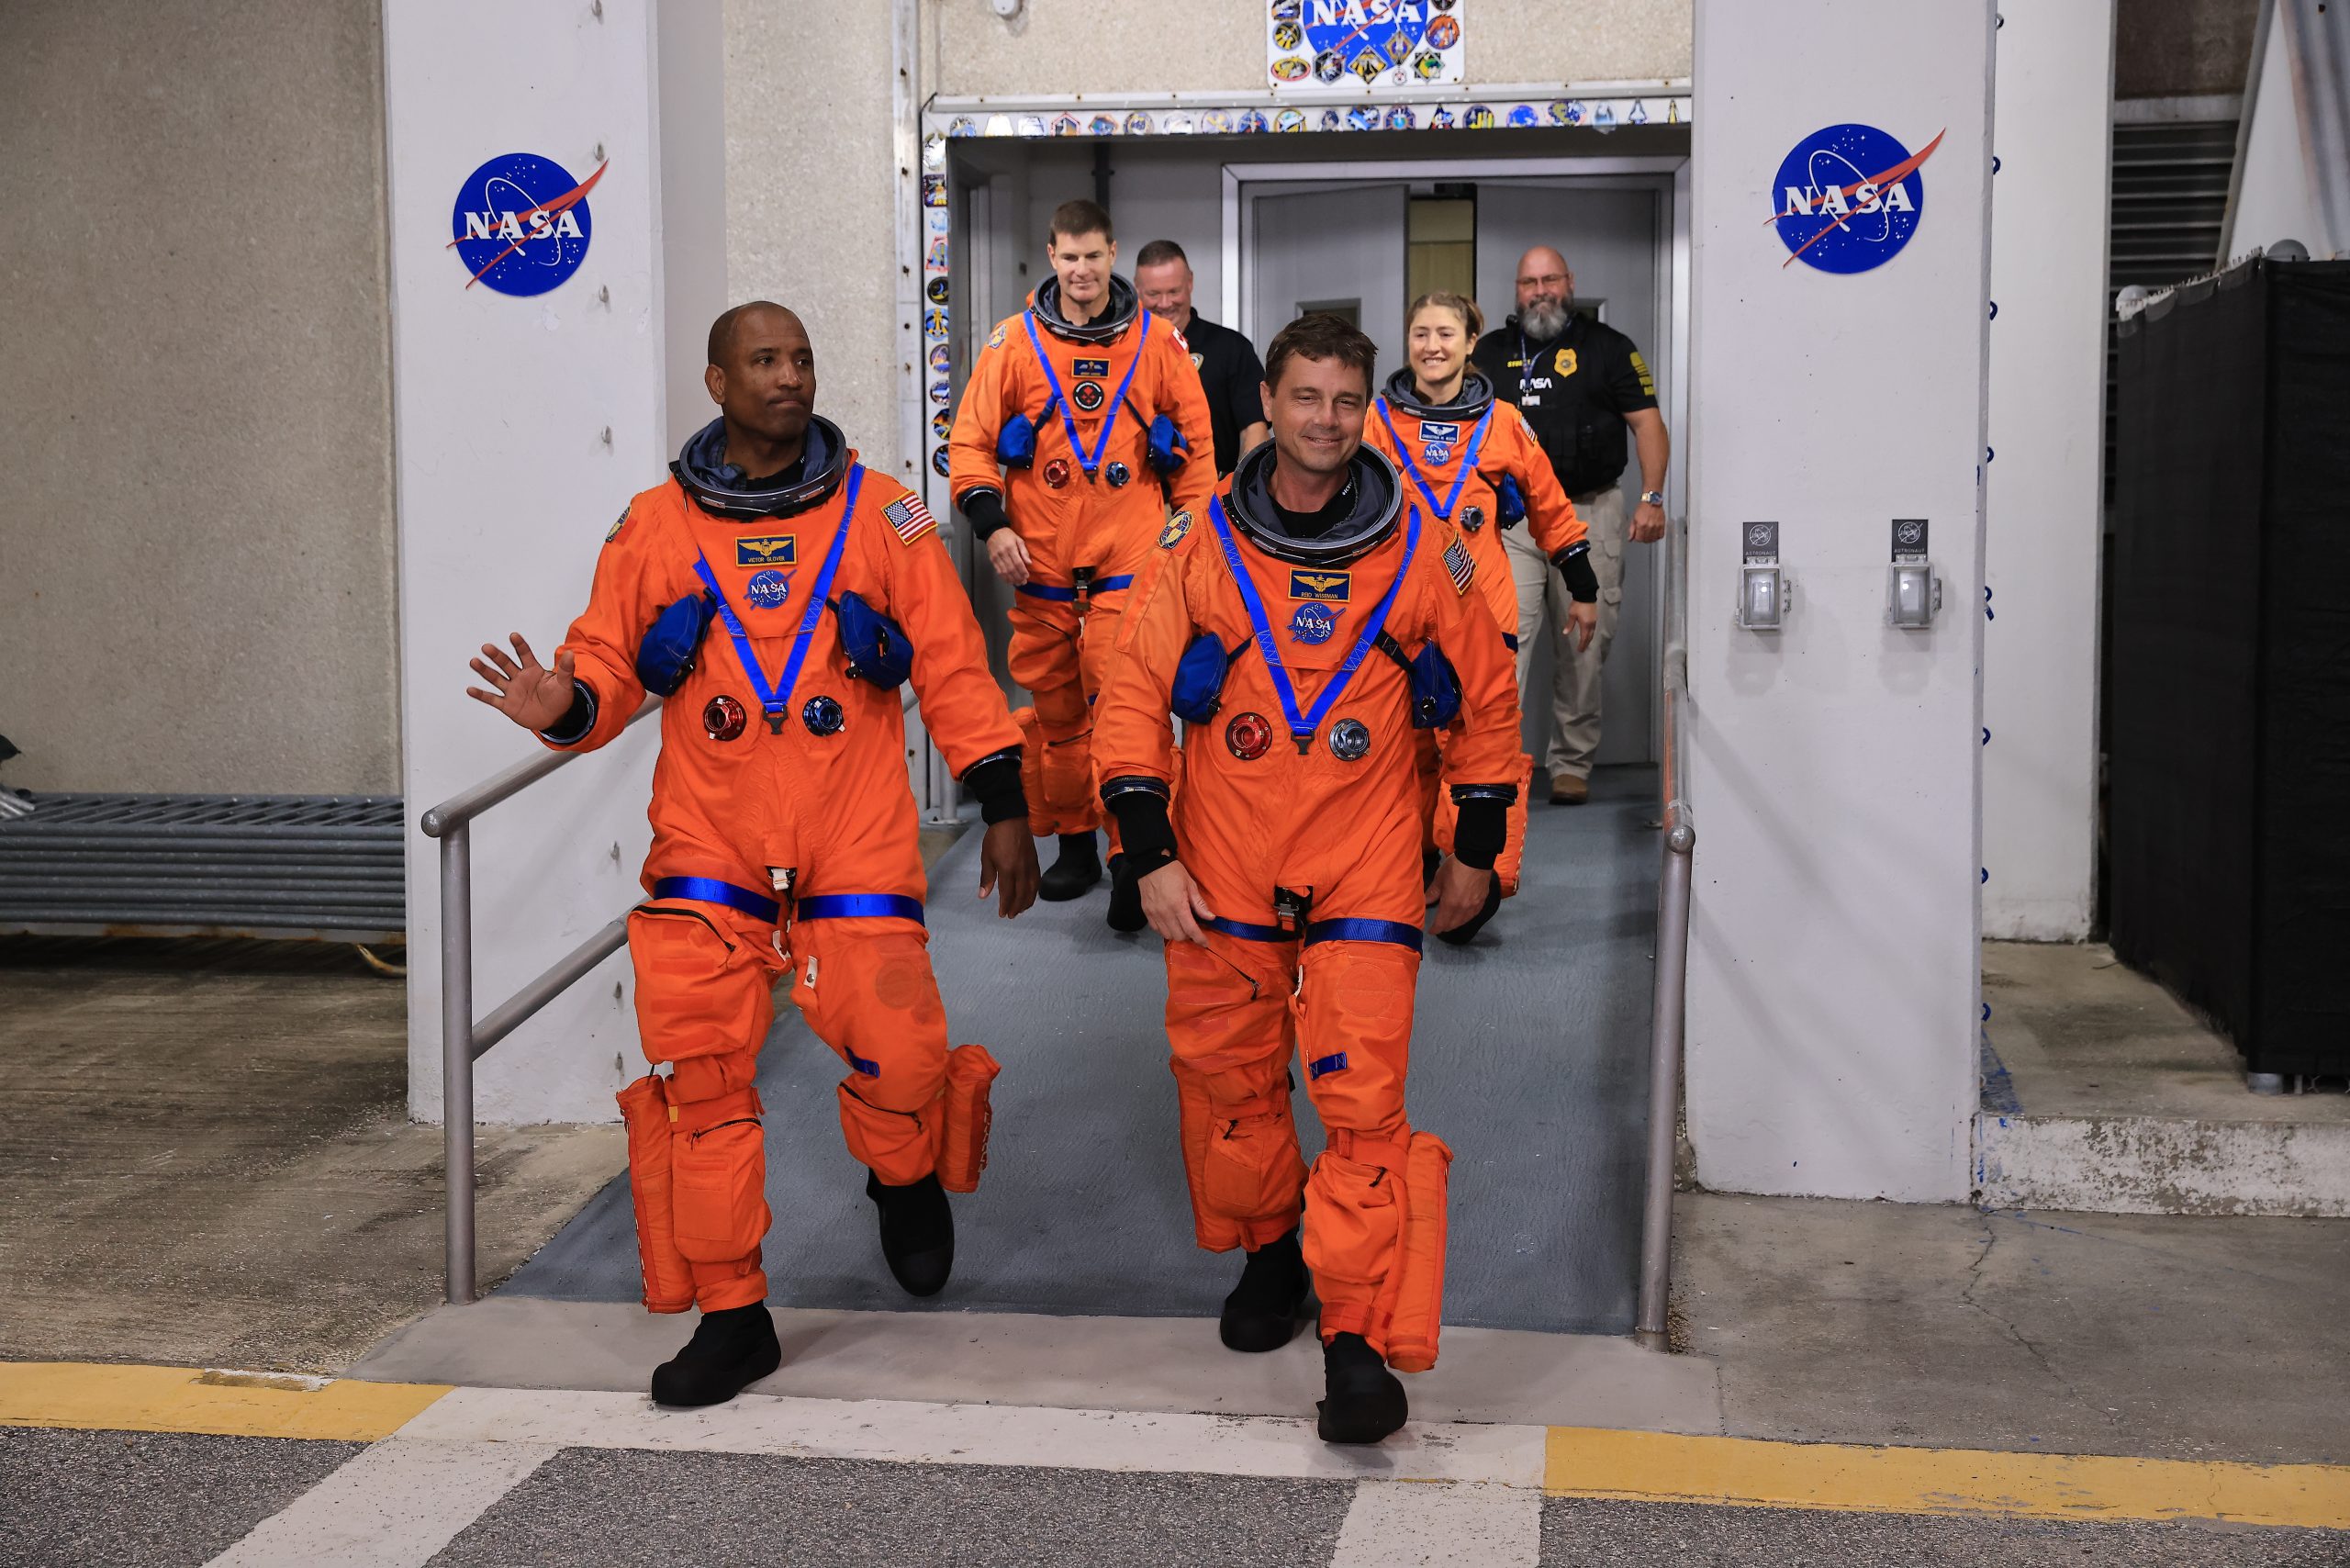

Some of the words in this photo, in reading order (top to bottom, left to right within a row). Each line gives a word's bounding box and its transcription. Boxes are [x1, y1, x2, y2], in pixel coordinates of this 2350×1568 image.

[1312, 0, 1423, 26] NASA
[1784, 183, 1915, 216] NASA
[464, 209, 584, 240] NASA
[1426, 449, 1449, 457] NASA
[751, 582, 787, 594] NASA
[1295, 616, 1331, 631] NASA
